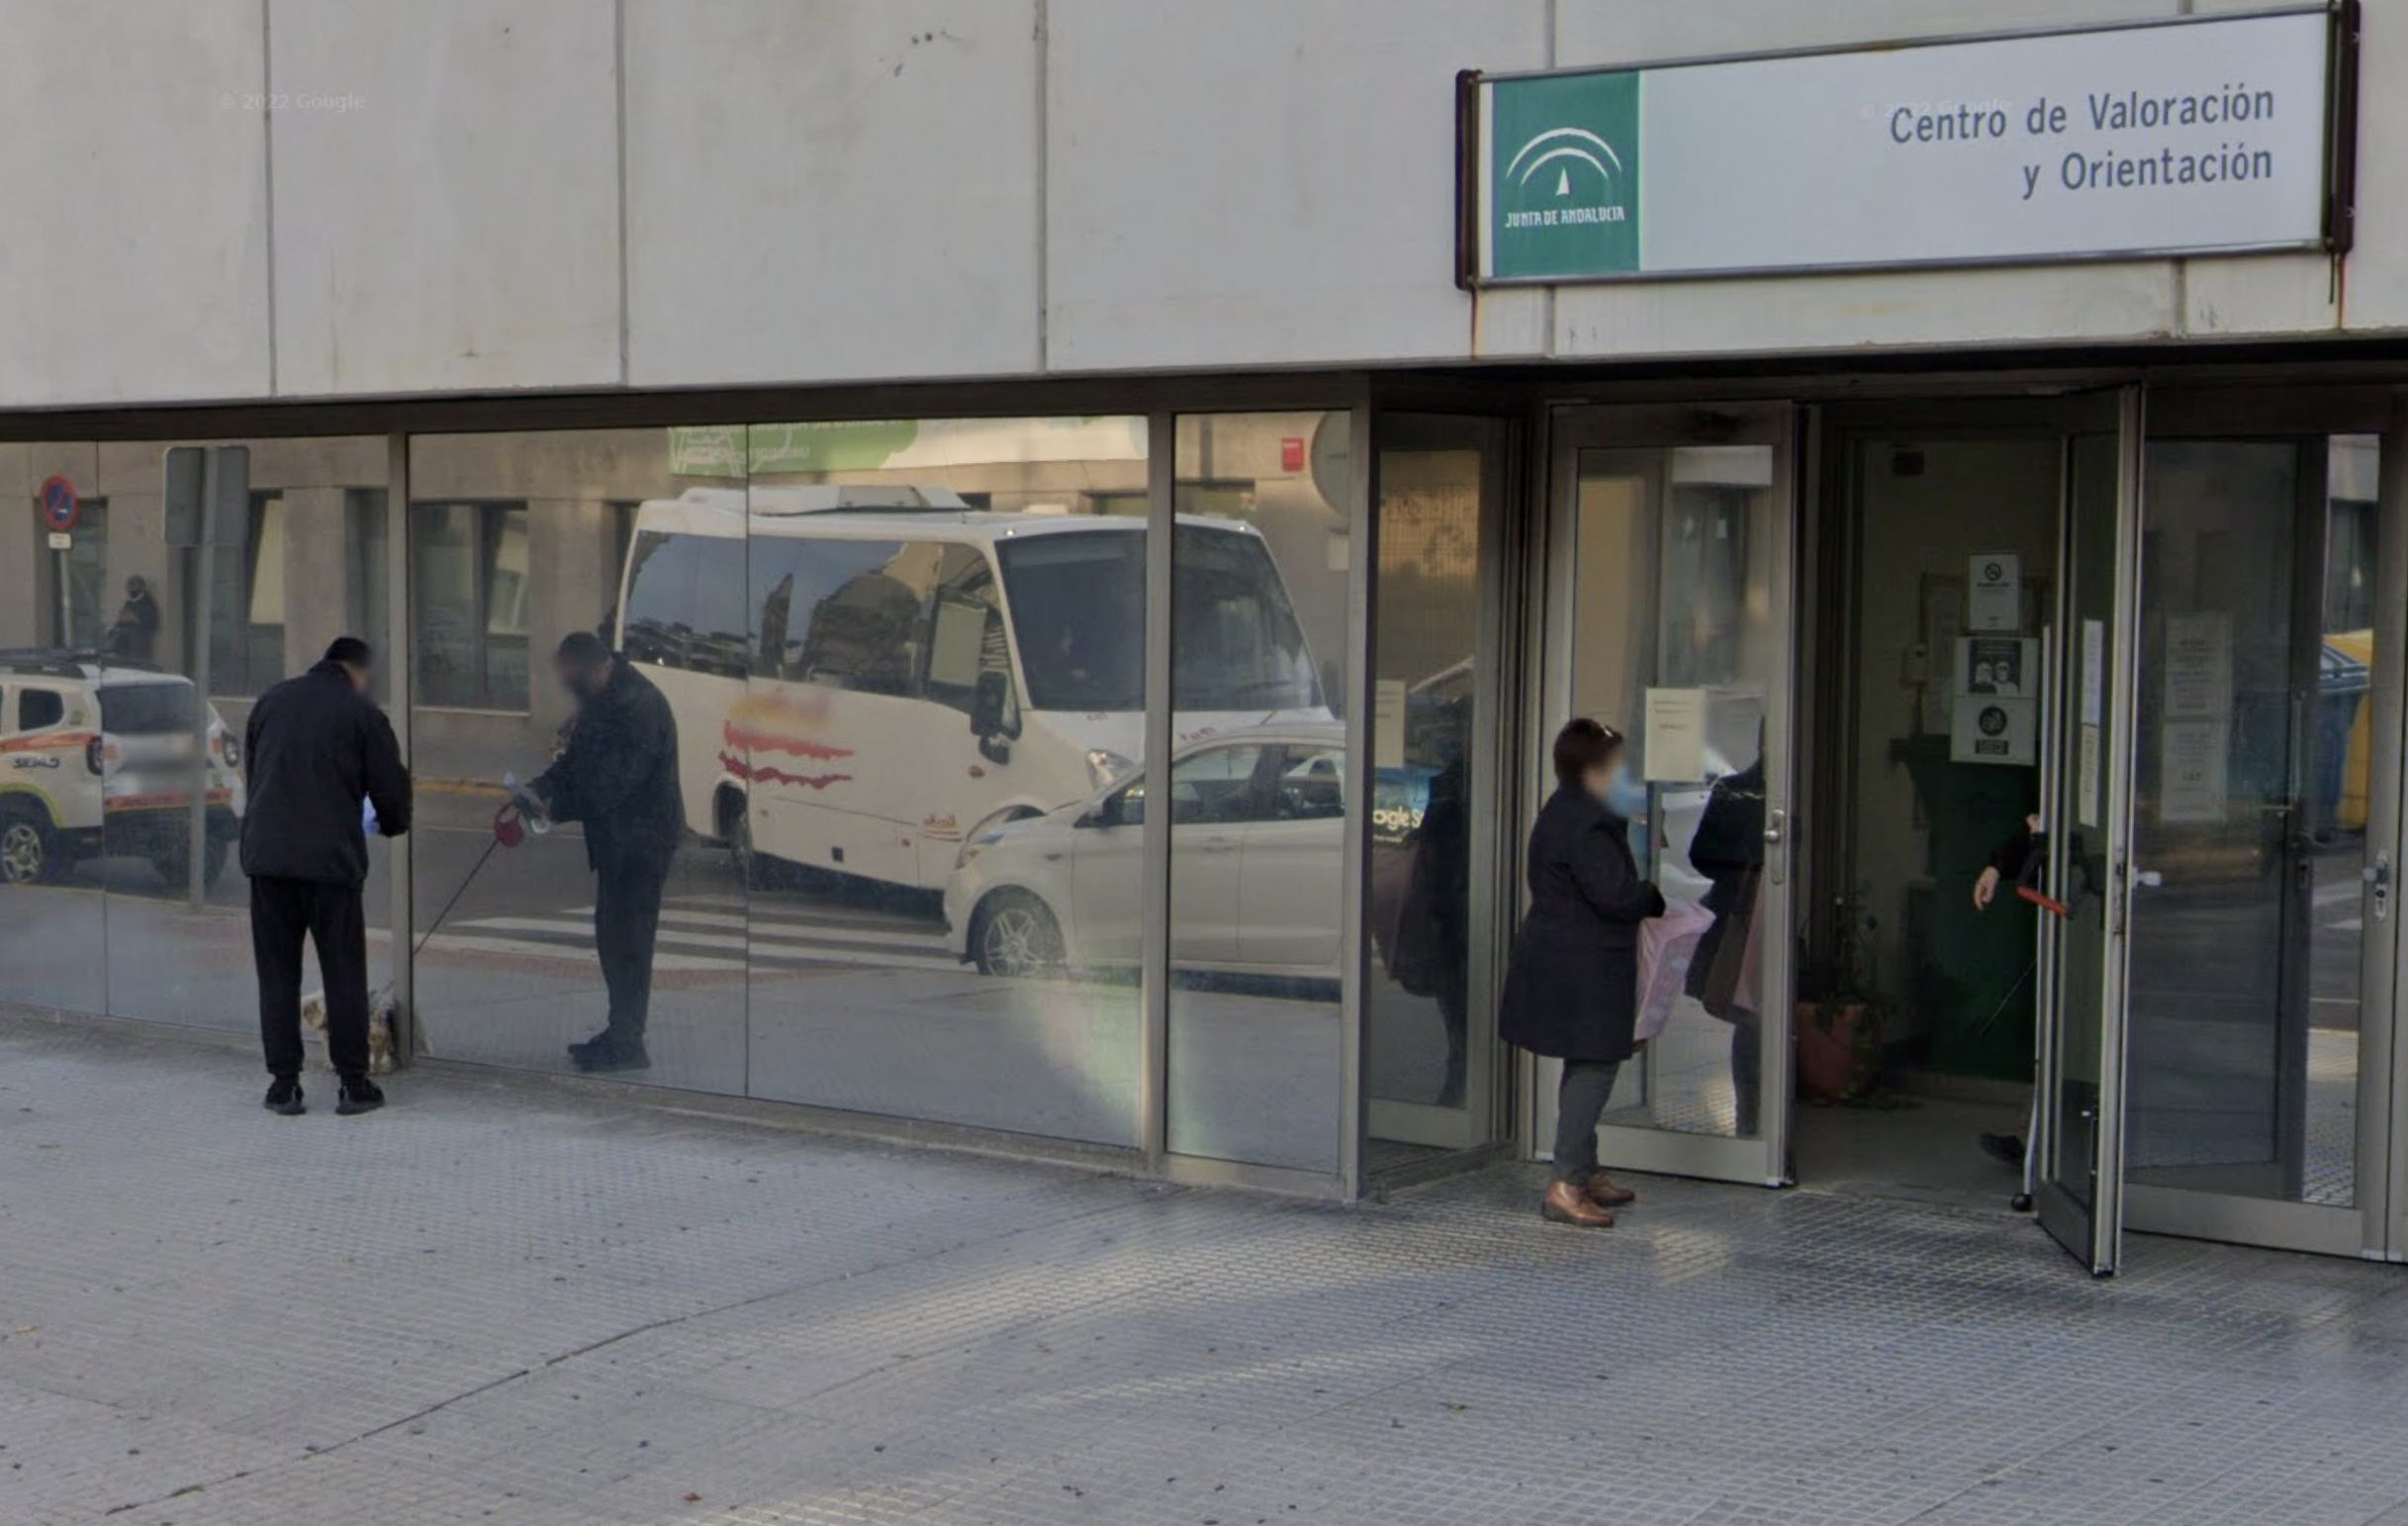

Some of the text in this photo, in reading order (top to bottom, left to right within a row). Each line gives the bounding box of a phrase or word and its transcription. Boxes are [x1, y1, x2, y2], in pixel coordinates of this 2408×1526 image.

[1891, 83, 2274, 143] Centro de Valoración
[2022, 143, 2273, 200] y Orientación
[1505, 205, 1625, 228] JUNTA DE ANDALUCIA
